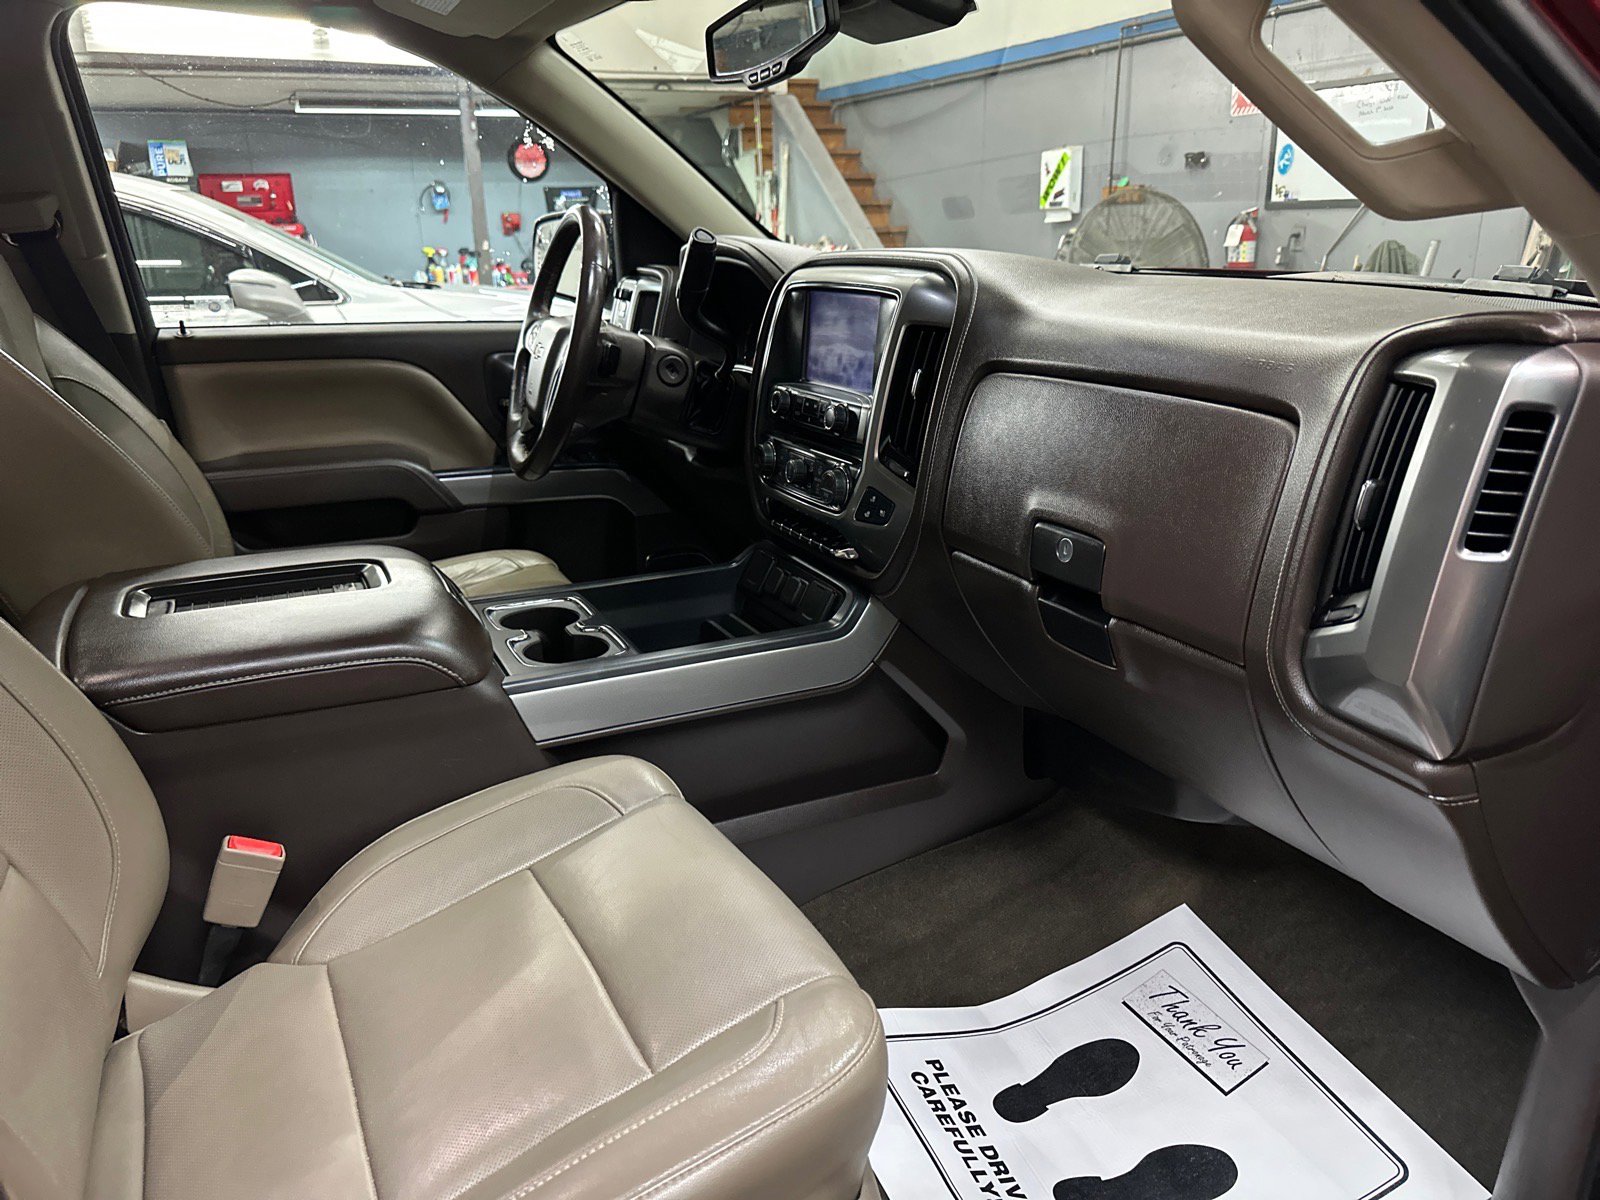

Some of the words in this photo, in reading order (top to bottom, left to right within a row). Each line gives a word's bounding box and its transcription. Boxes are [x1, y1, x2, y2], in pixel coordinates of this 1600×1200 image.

[1149, 985, 1221, 1038] Thank
[1208, 1038, 1246, 1071] You
[1176, 1036, 1212, 1068] Patronage
[911, 1071, 1003, 1200] CAREFULLY
[925, 1059, 987, 1138] PLEASE
